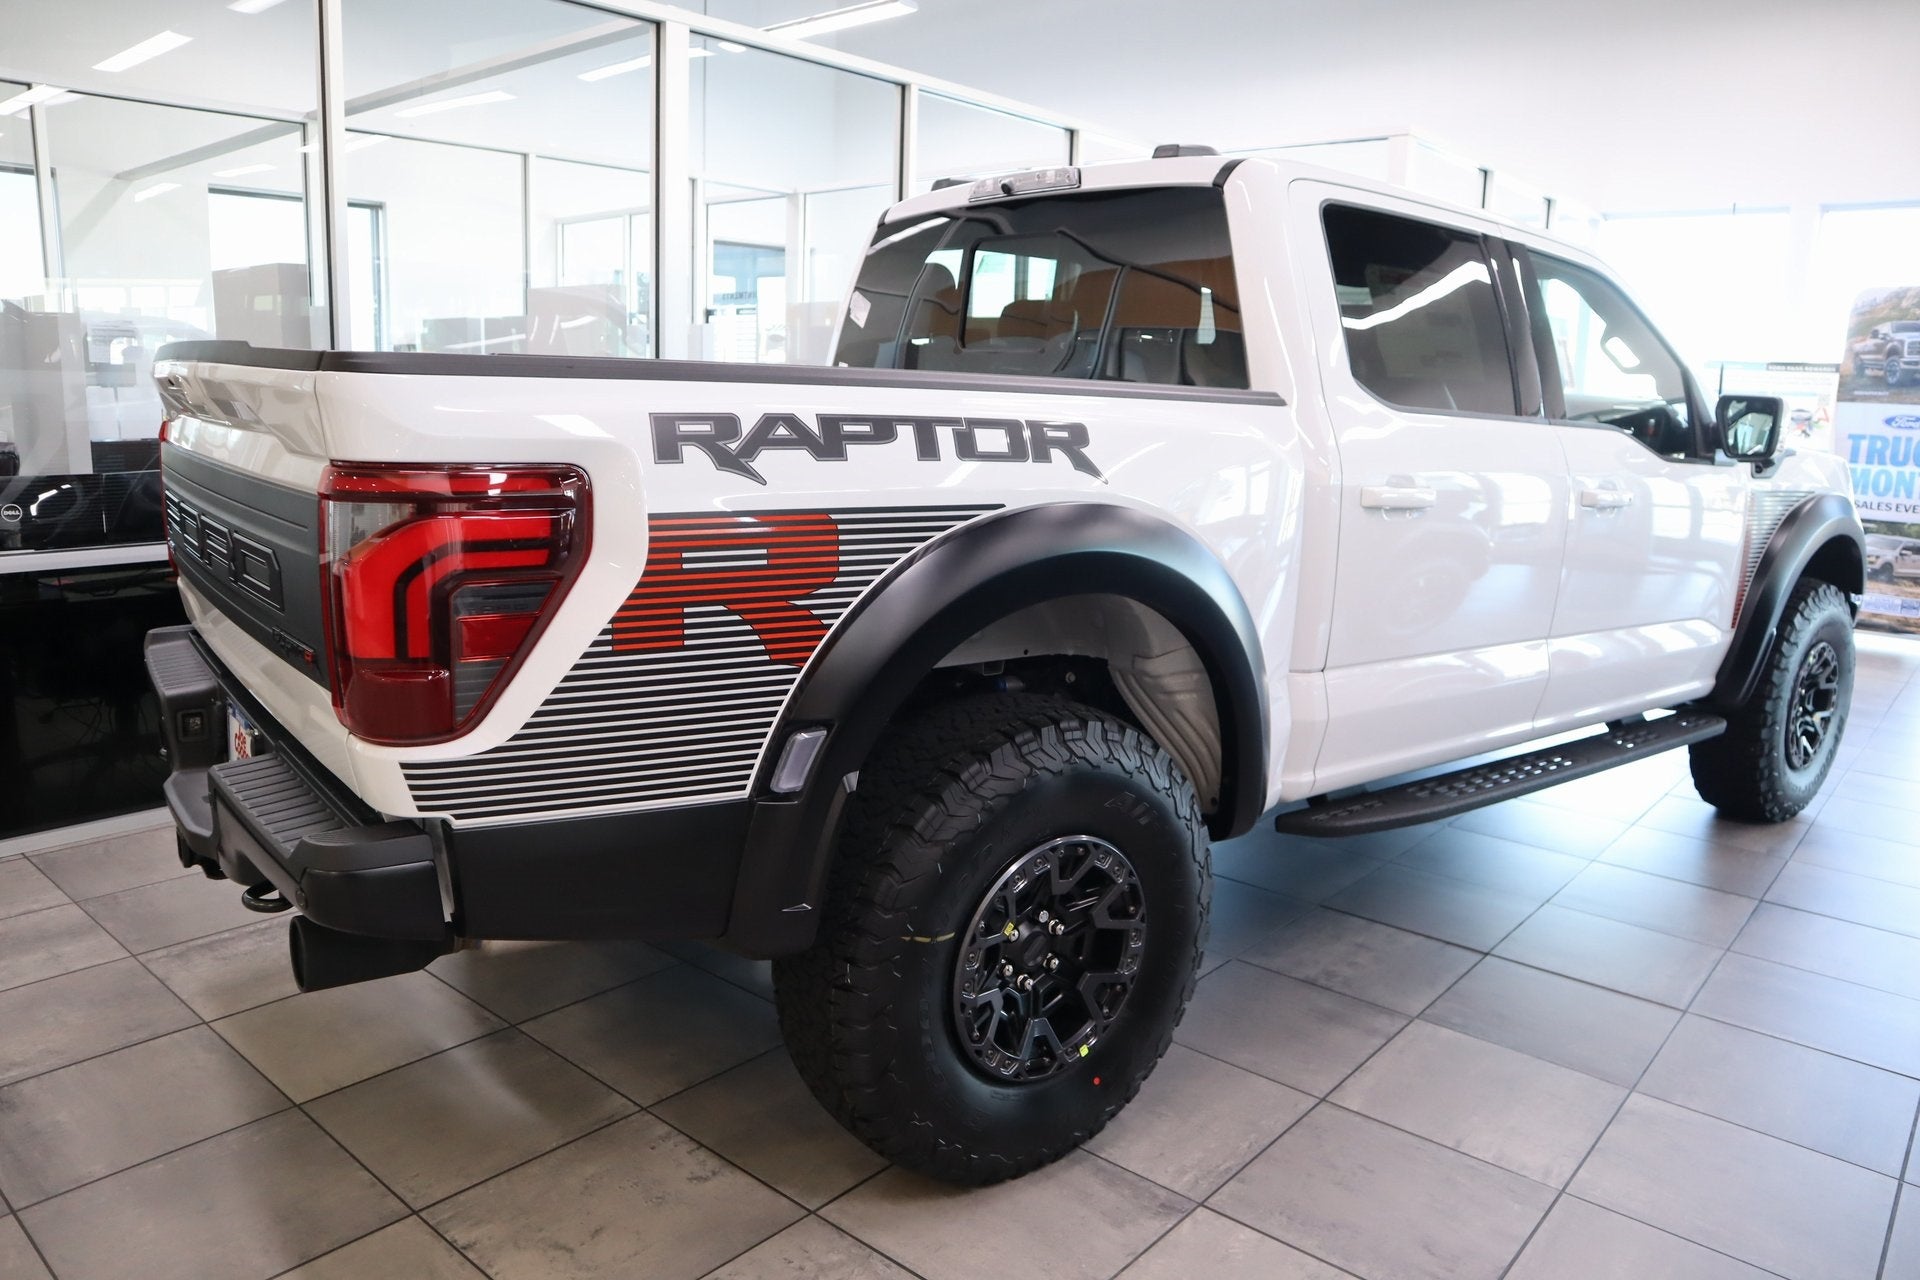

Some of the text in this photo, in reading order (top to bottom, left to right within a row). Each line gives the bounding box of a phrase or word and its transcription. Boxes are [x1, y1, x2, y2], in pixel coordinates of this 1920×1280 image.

[649, 413, 1109, 485] RAPTOR
[1850, 467, 1920, 499] MON
[1854, 499, 1892, 512] SALES
[165, 488, 285, 616] FORD
